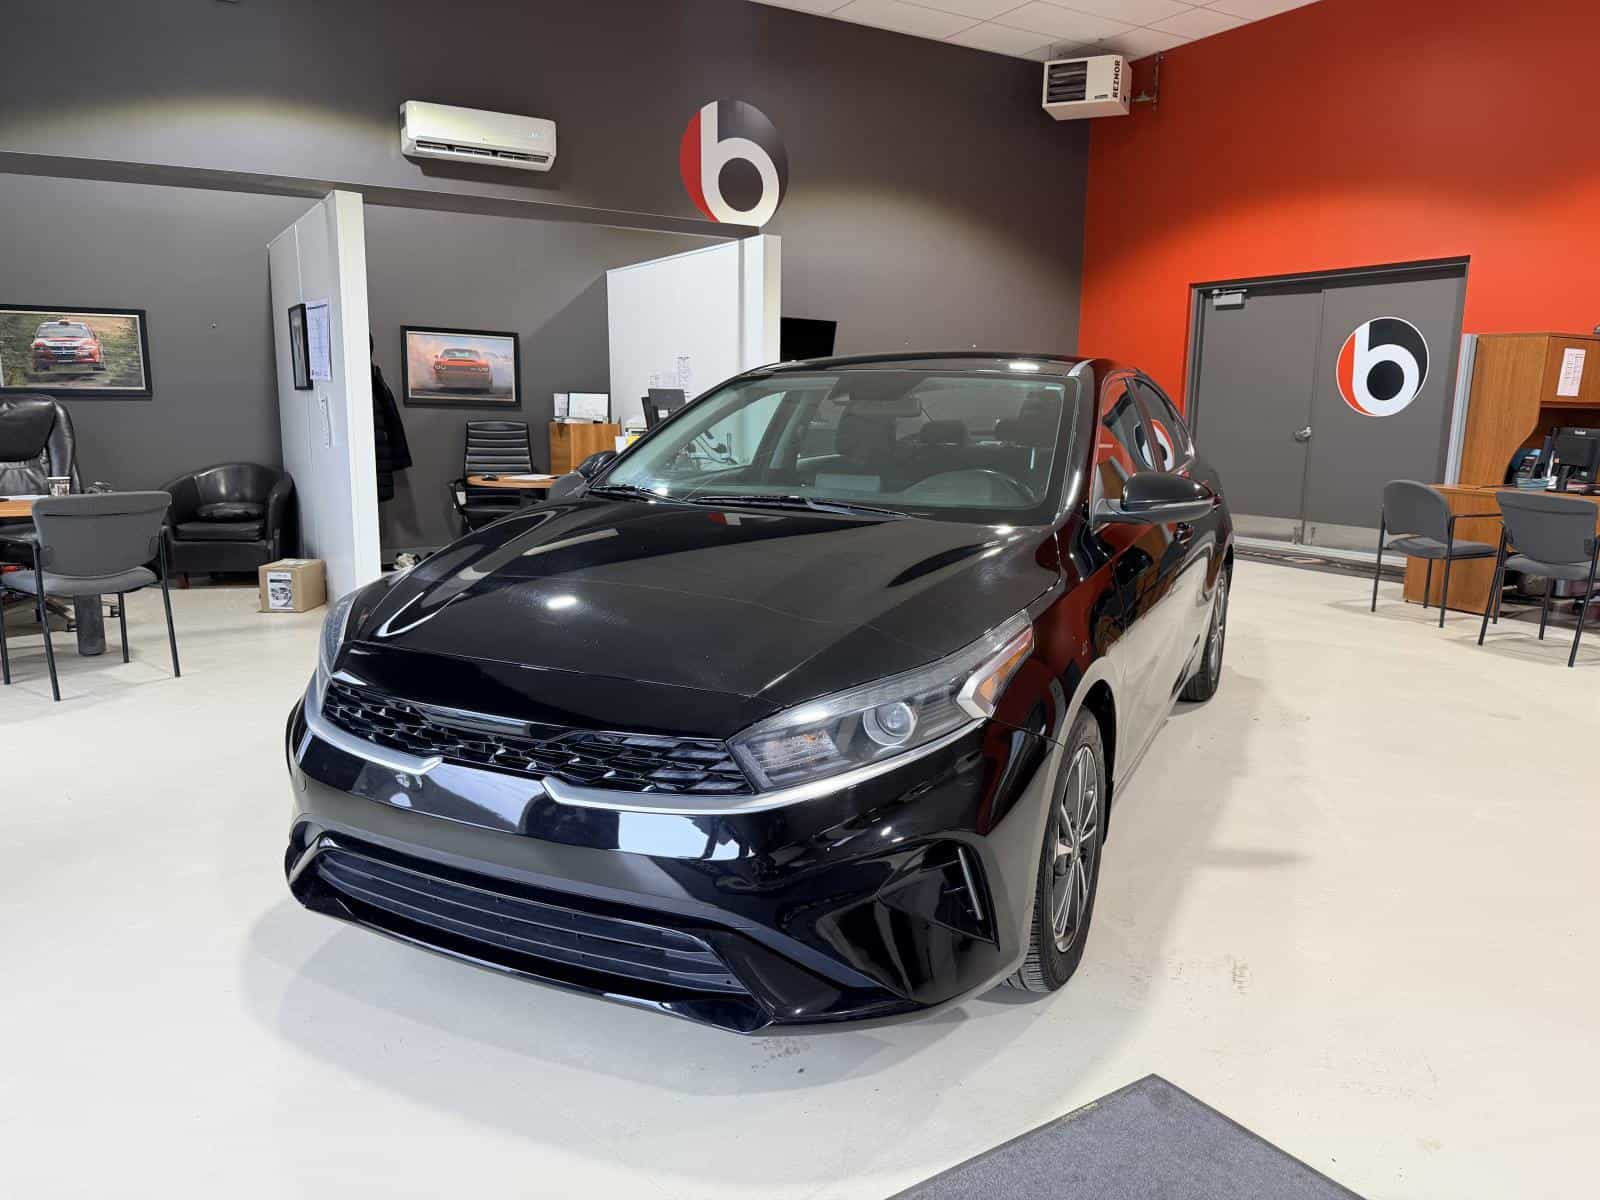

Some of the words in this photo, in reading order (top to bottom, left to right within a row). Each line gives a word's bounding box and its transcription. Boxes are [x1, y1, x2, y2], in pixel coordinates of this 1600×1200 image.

[1112, 60, 1121, 98] REZNOR
[700, 100, 780, 227] b
[1352, 319, 1420, 416] b
